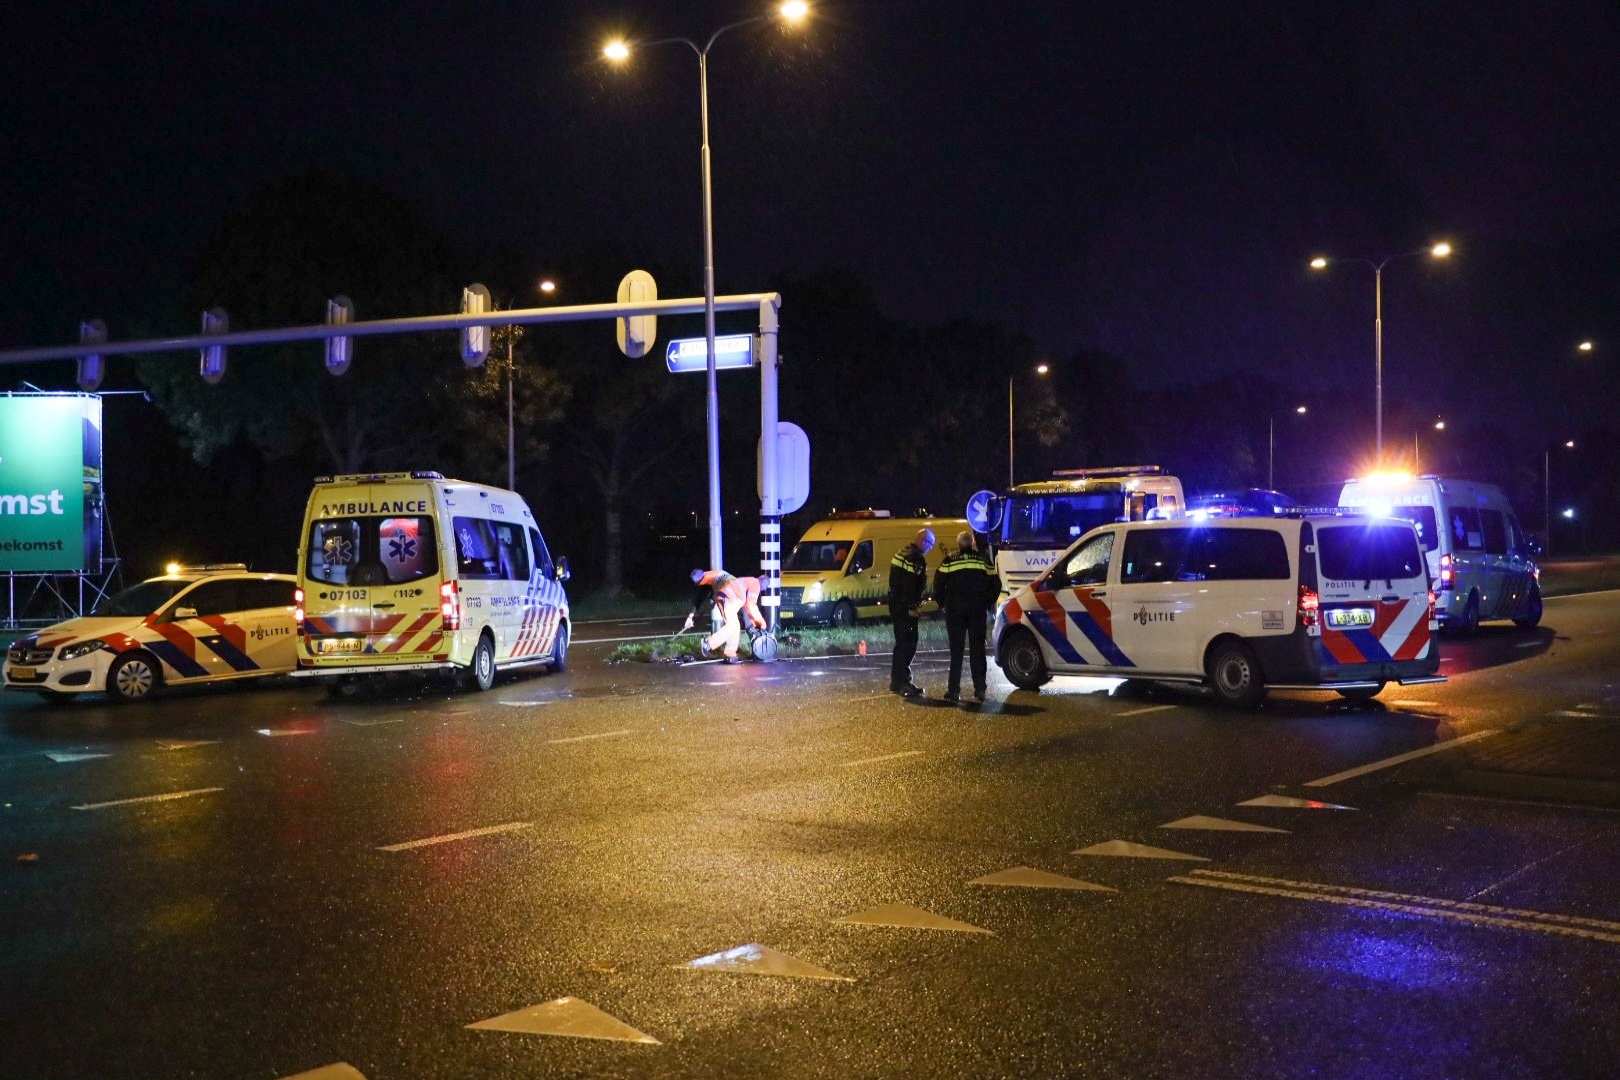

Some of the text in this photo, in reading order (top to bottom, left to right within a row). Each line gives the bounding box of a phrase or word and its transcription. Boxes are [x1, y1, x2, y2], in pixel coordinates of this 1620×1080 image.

[321, 501, 427, 515] AMBULANCE
[1025, 558, 1049, 566] VAN
[1325, 581, 1356, 589] POLITIE
[329, 589, 367, 601] 07103
[466, 597, 482, 608] 07103
[490, 596, 521, 607] AMBULANCE
[1133, 607, 1175, 626] POLITIE
[250, 626, 290, 641] POLITIE
